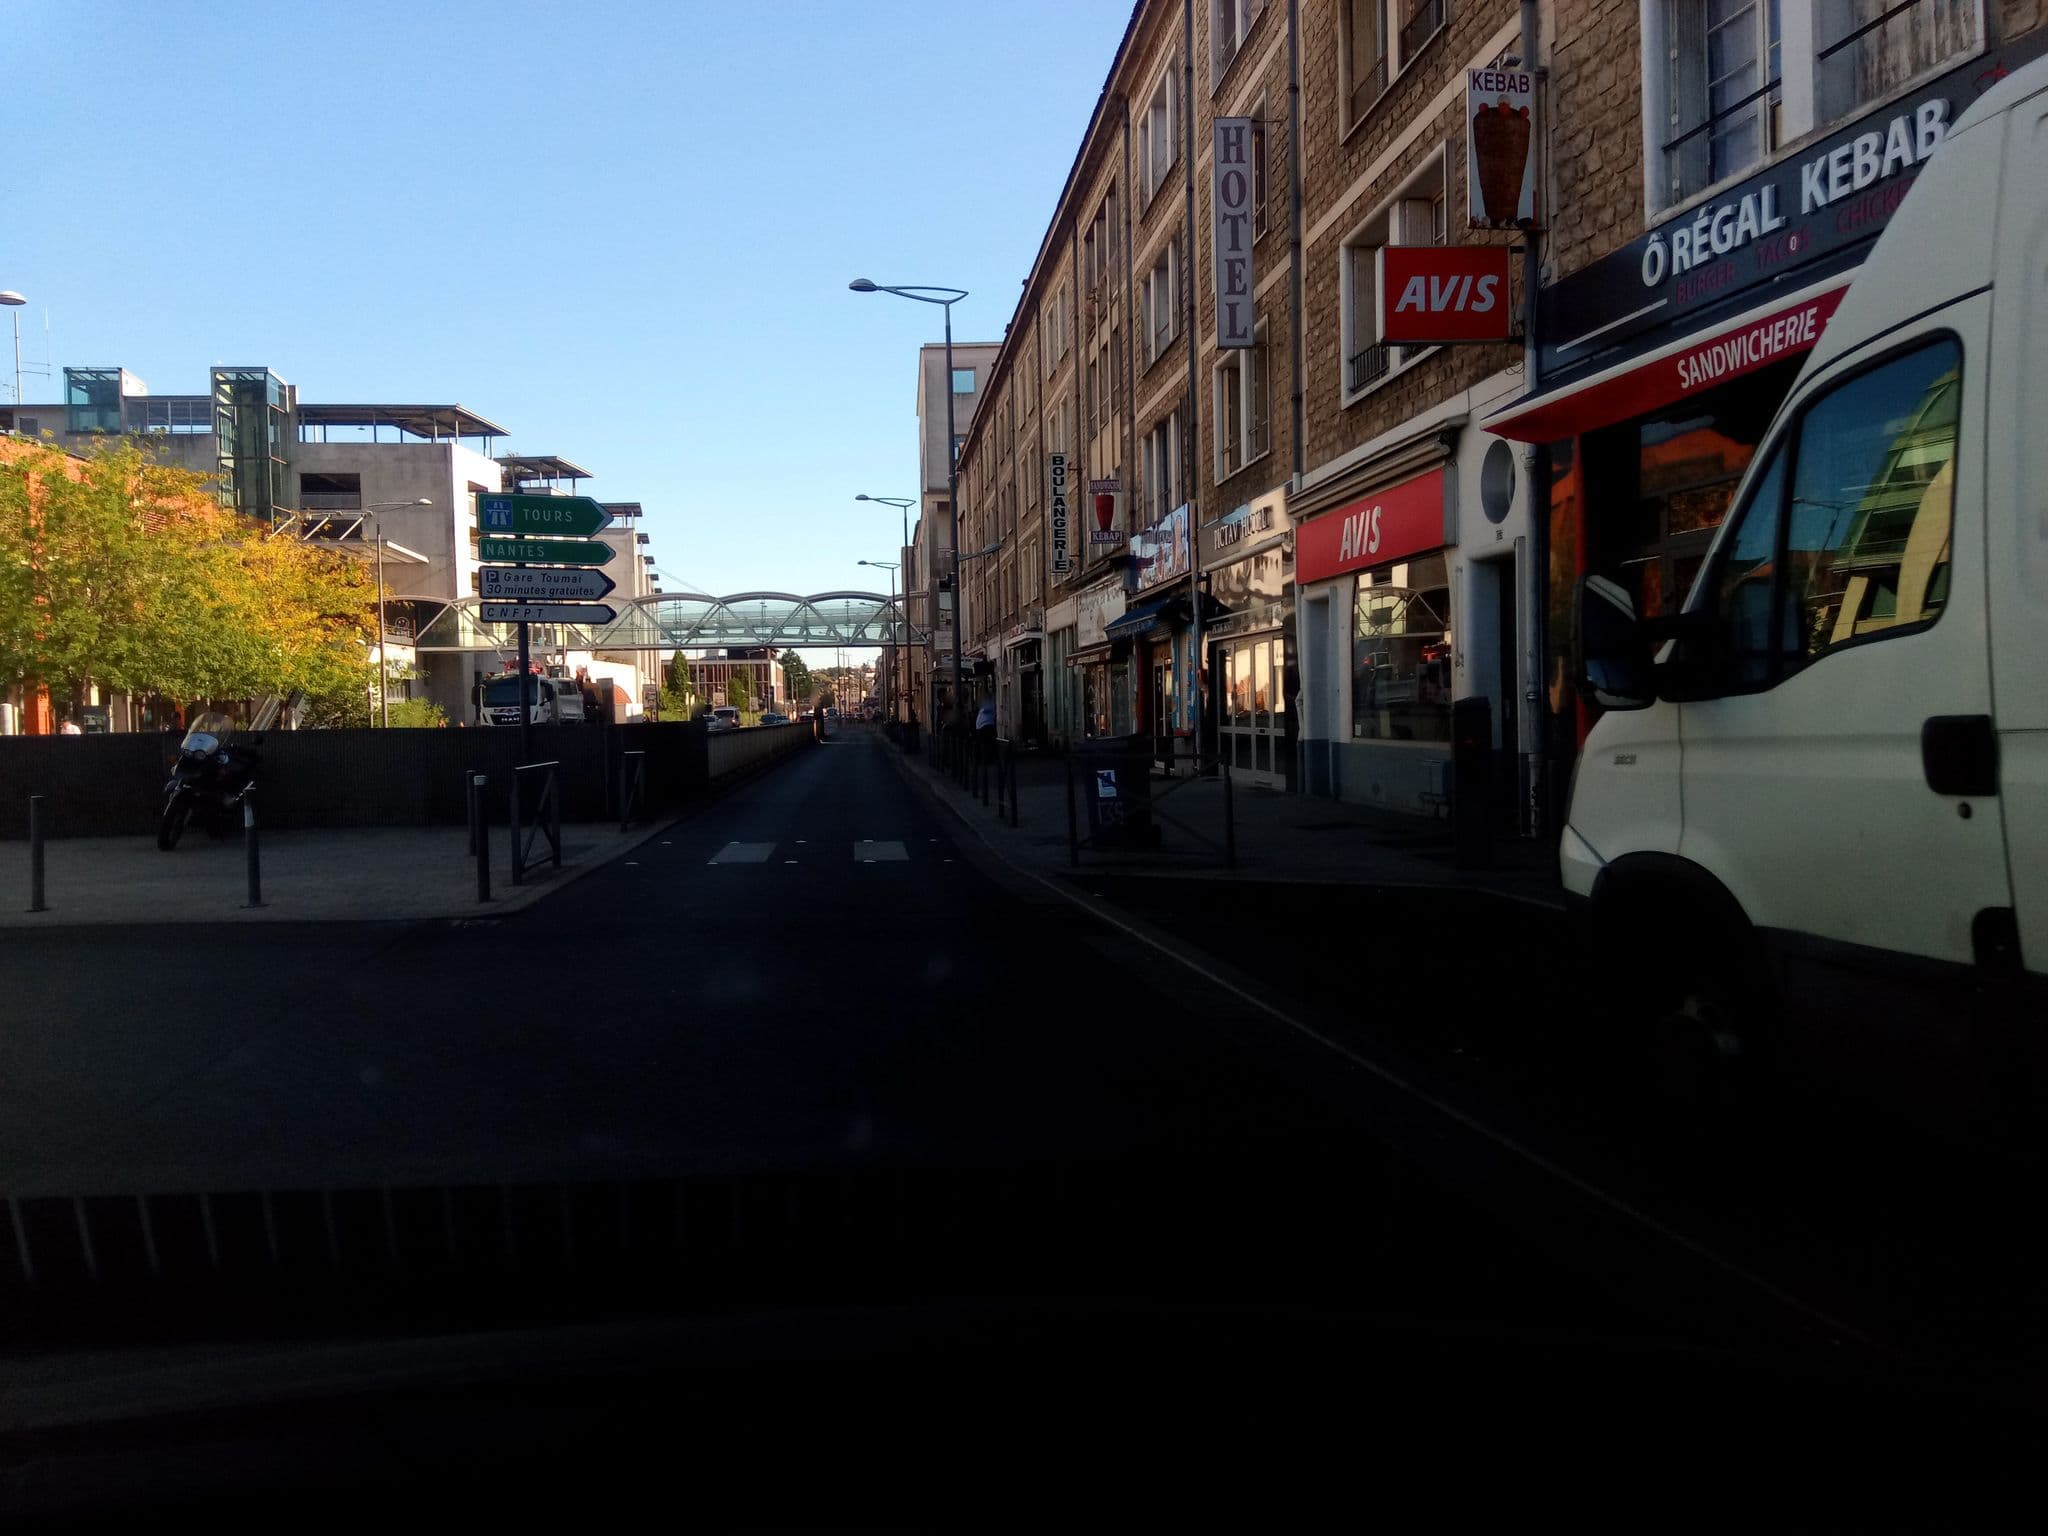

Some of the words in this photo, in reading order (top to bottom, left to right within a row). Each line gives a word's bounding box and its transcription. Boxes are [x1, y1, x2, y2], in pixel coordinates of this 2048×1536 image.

[1472, 71, 1530, 94] KEBAB
[1671, 184, 1786, 276] RÉGAL
[1801, 97, 1952, 215] KEBAB
[1219, 126, 1248, 341] HOTEL
[1676, 262, 1735, 305] BURGER
[1757, 226, 1810, 268] TACOS
[1394, 274, 1500, 313] AVIS
[1677, 306, 1818, 389] SANDWICHERIE
[523, 509, 573, 522] TOURS
[1052, 455, 1067, 570] BOULANGERIE
[1339, 505, 1382, 562] AVIS
[486, 543, 545, 558] NANTES
[486, 584, 501, 594] 30
[504, 585, 546, 595] minutes
[549, 586, 594, 599] gratuites
[503, 572, 533, 582] Gare
